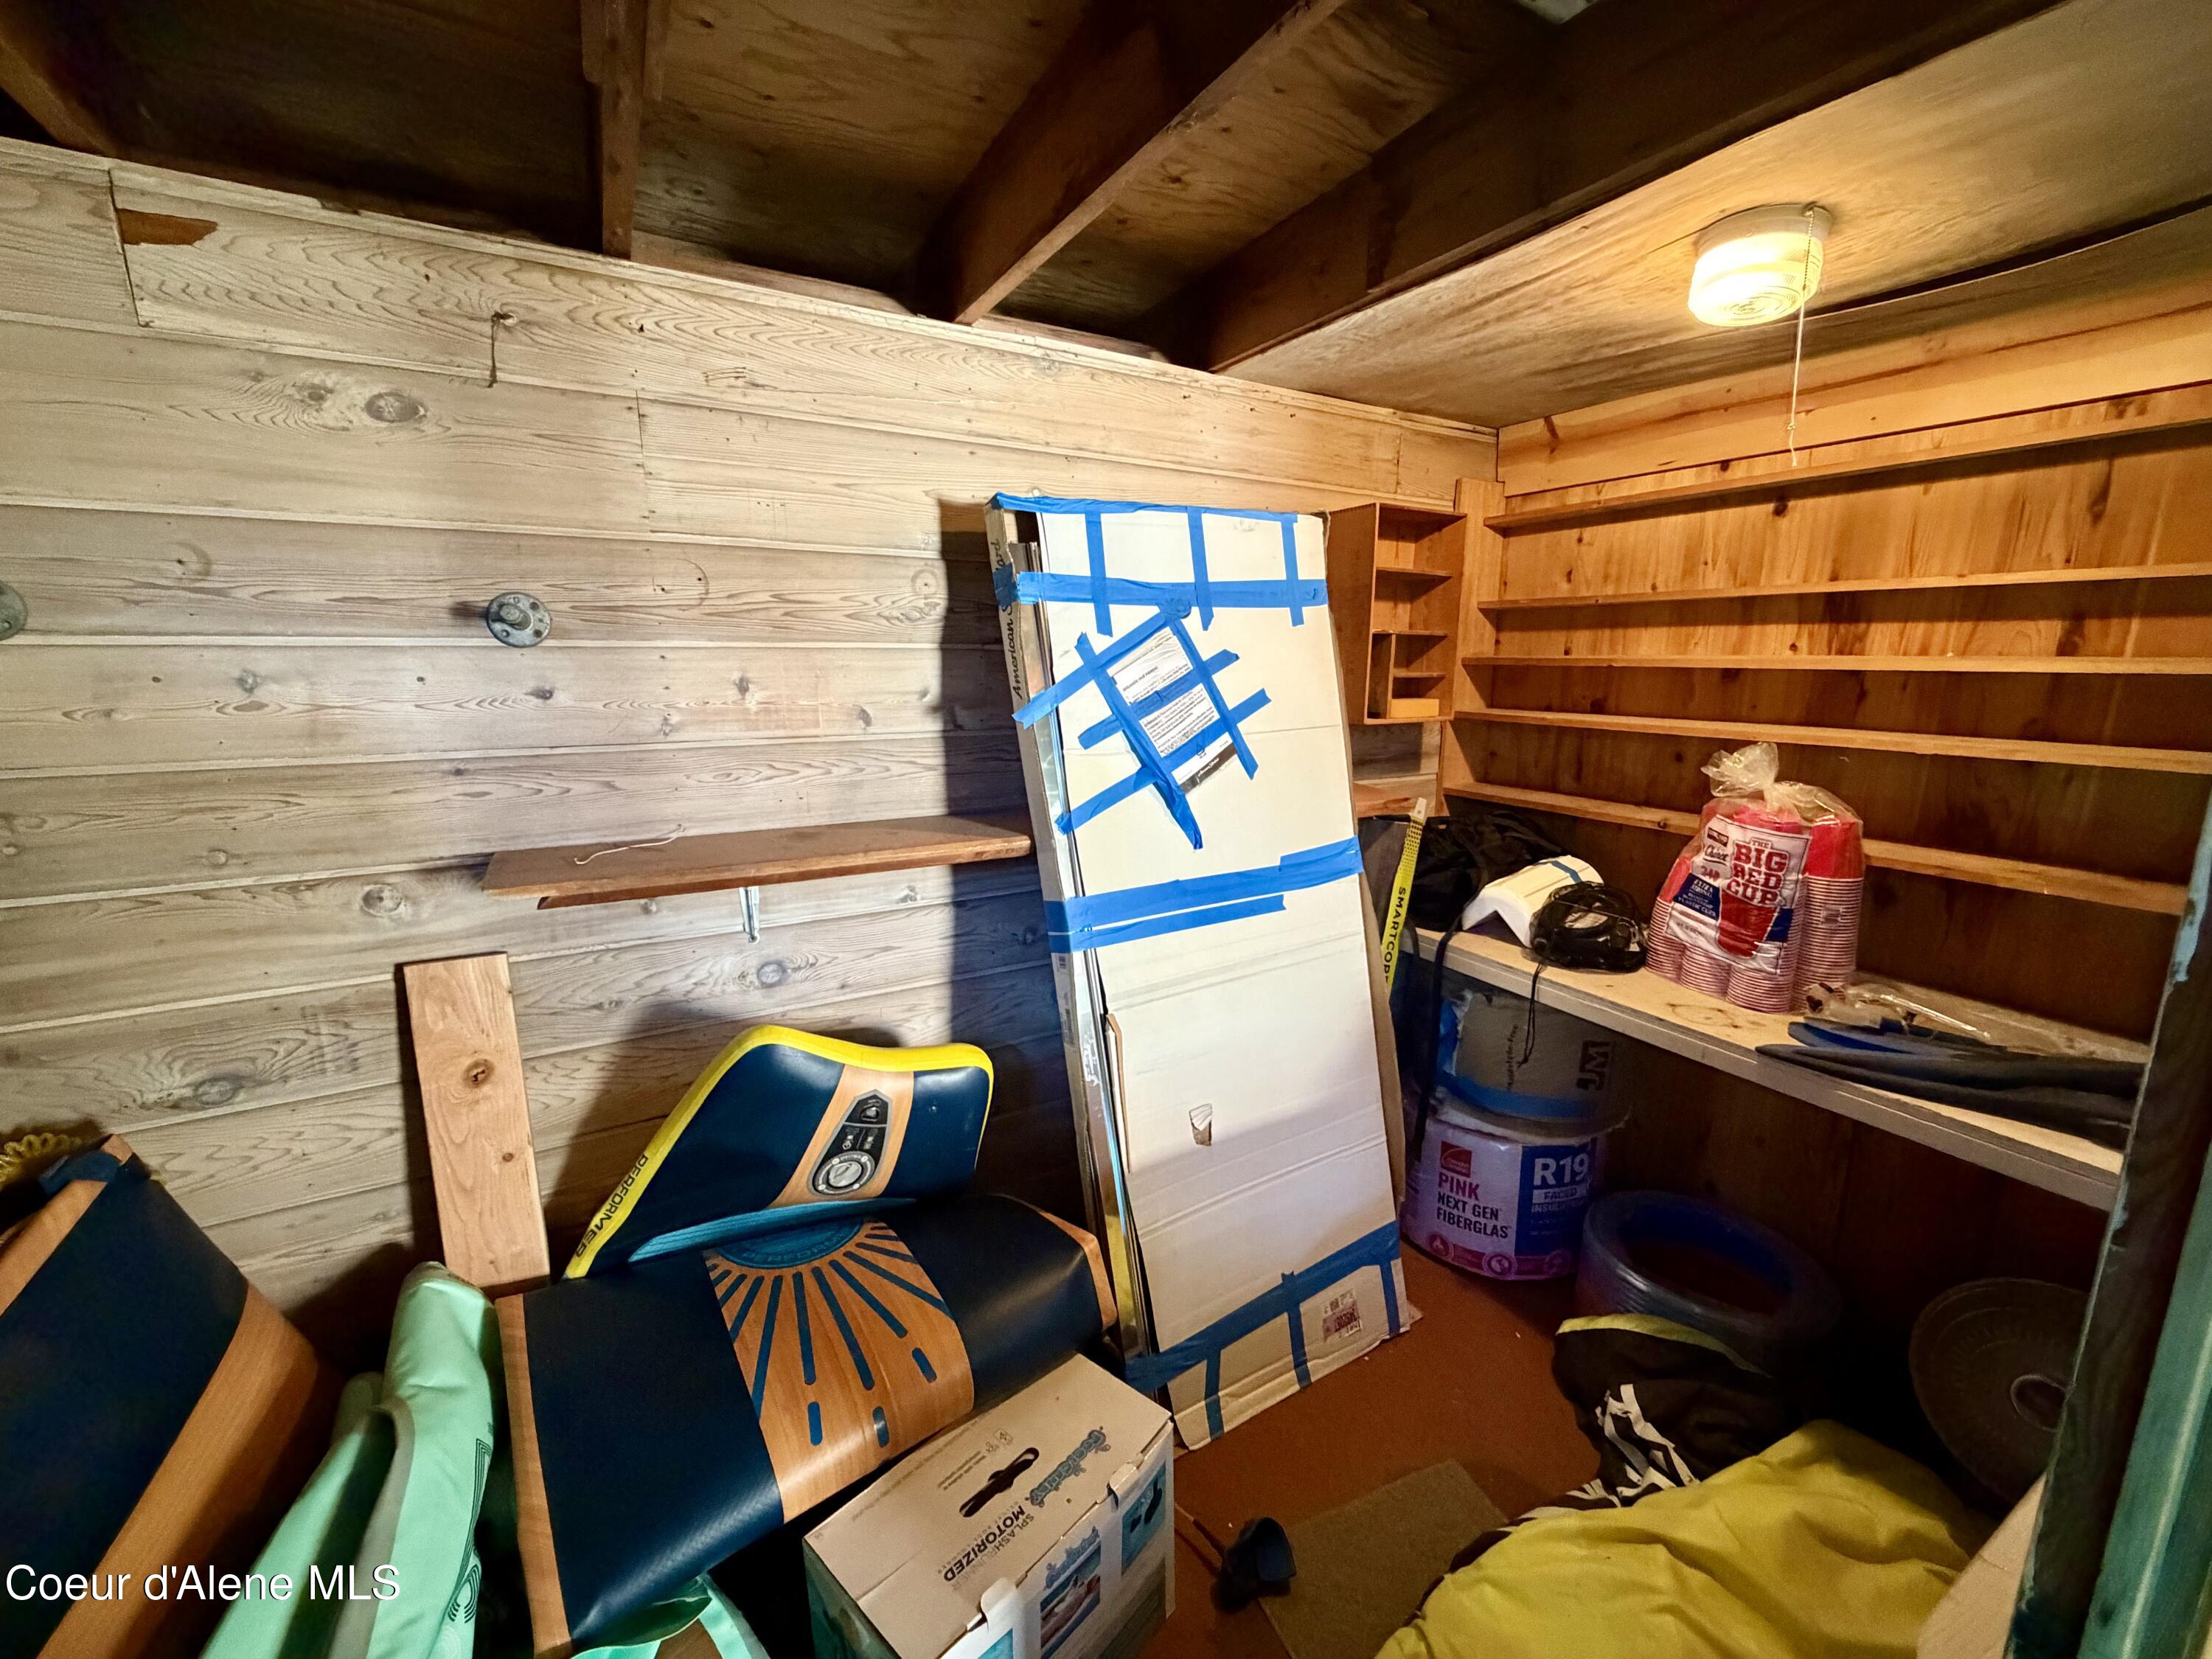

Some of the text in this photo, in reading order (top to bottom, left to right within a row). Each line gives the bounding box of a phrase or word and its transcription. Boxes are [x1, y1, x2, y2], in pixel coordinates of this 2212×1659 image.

[1006, 618, 1023, 700] American
[1733, 843, 1789, 872] BIG
[1751, 840, 1770, 849] THE
[1726, 878, 1779, 904] CUP
[1733, 862, 1783, 891] RED
[1383, 886, 1407, 983] SMARTCOR
[1576, 1040, 1613, 1091] JM
[1533, 1153, 1589, 1186] R19
[1438, 1171, 1481, 1202] PINK
[575, 1153, 649, 1258] PERFORMER
[1437, 1191, 1499, 1221] NEXT GEN
[1436, 1206, 1509, 1239] FIBERGLAS
[943, 1504, 1026, 1582] MOTORIZED
